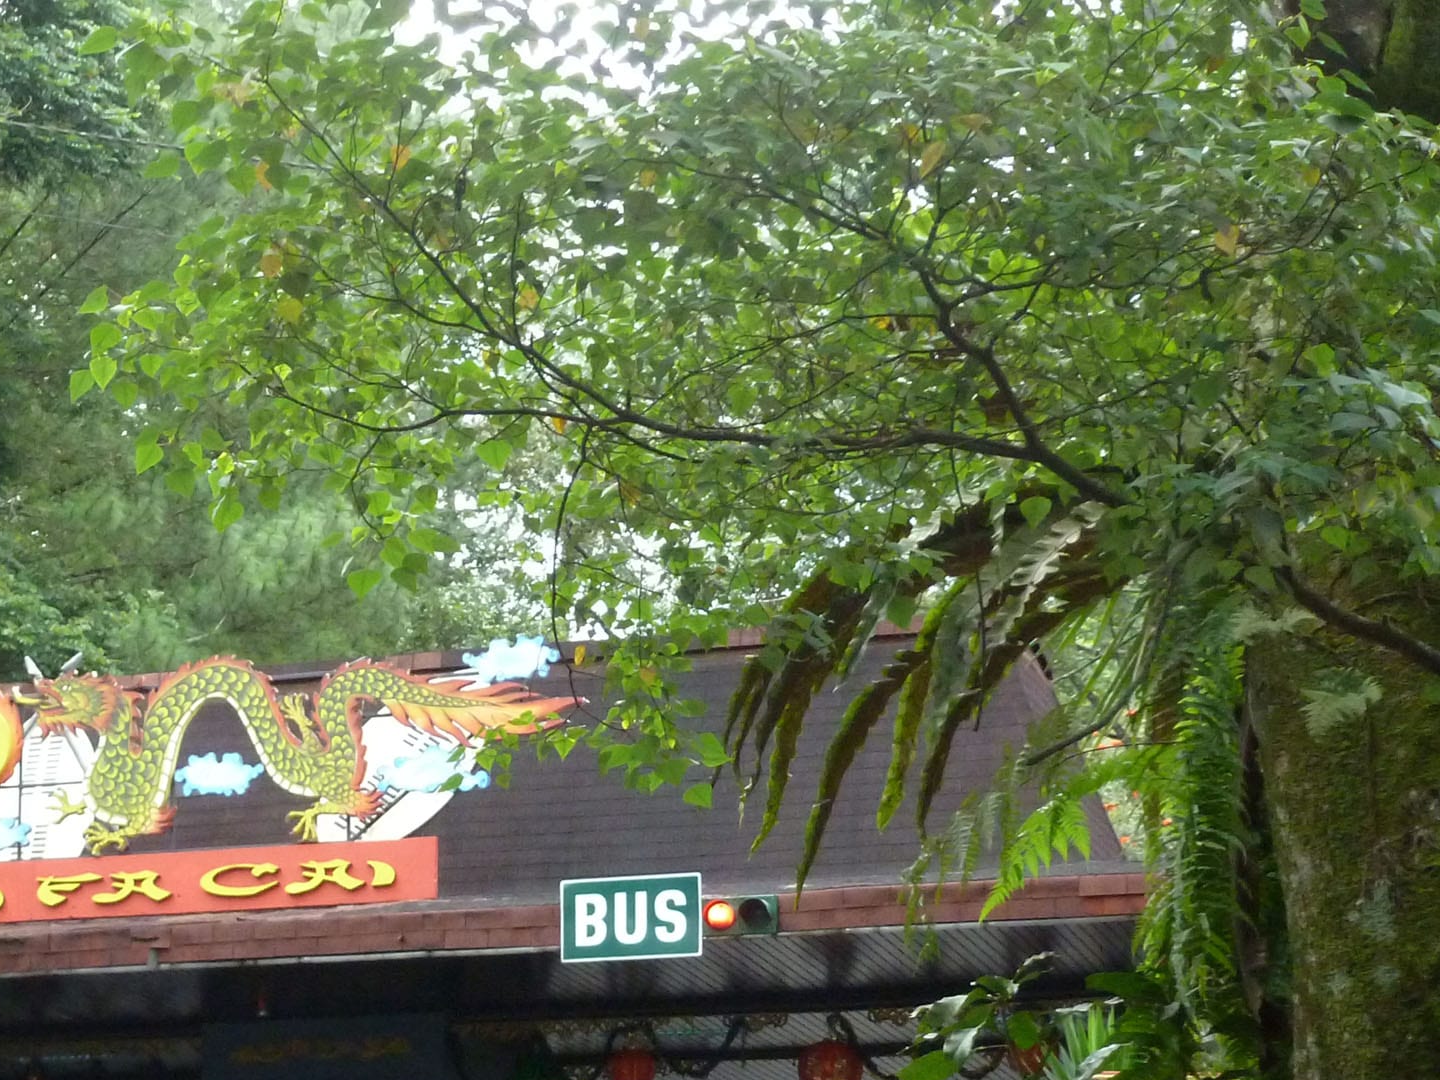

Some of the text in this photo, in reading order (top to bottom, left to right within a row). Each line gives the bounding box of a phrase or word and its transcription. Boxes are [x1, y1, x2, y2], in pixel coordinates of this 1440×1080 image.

[36, 869, 174, 907] FA
[199, 858, 398, 898] CAI
[574, 888, 687, 948] BUS
